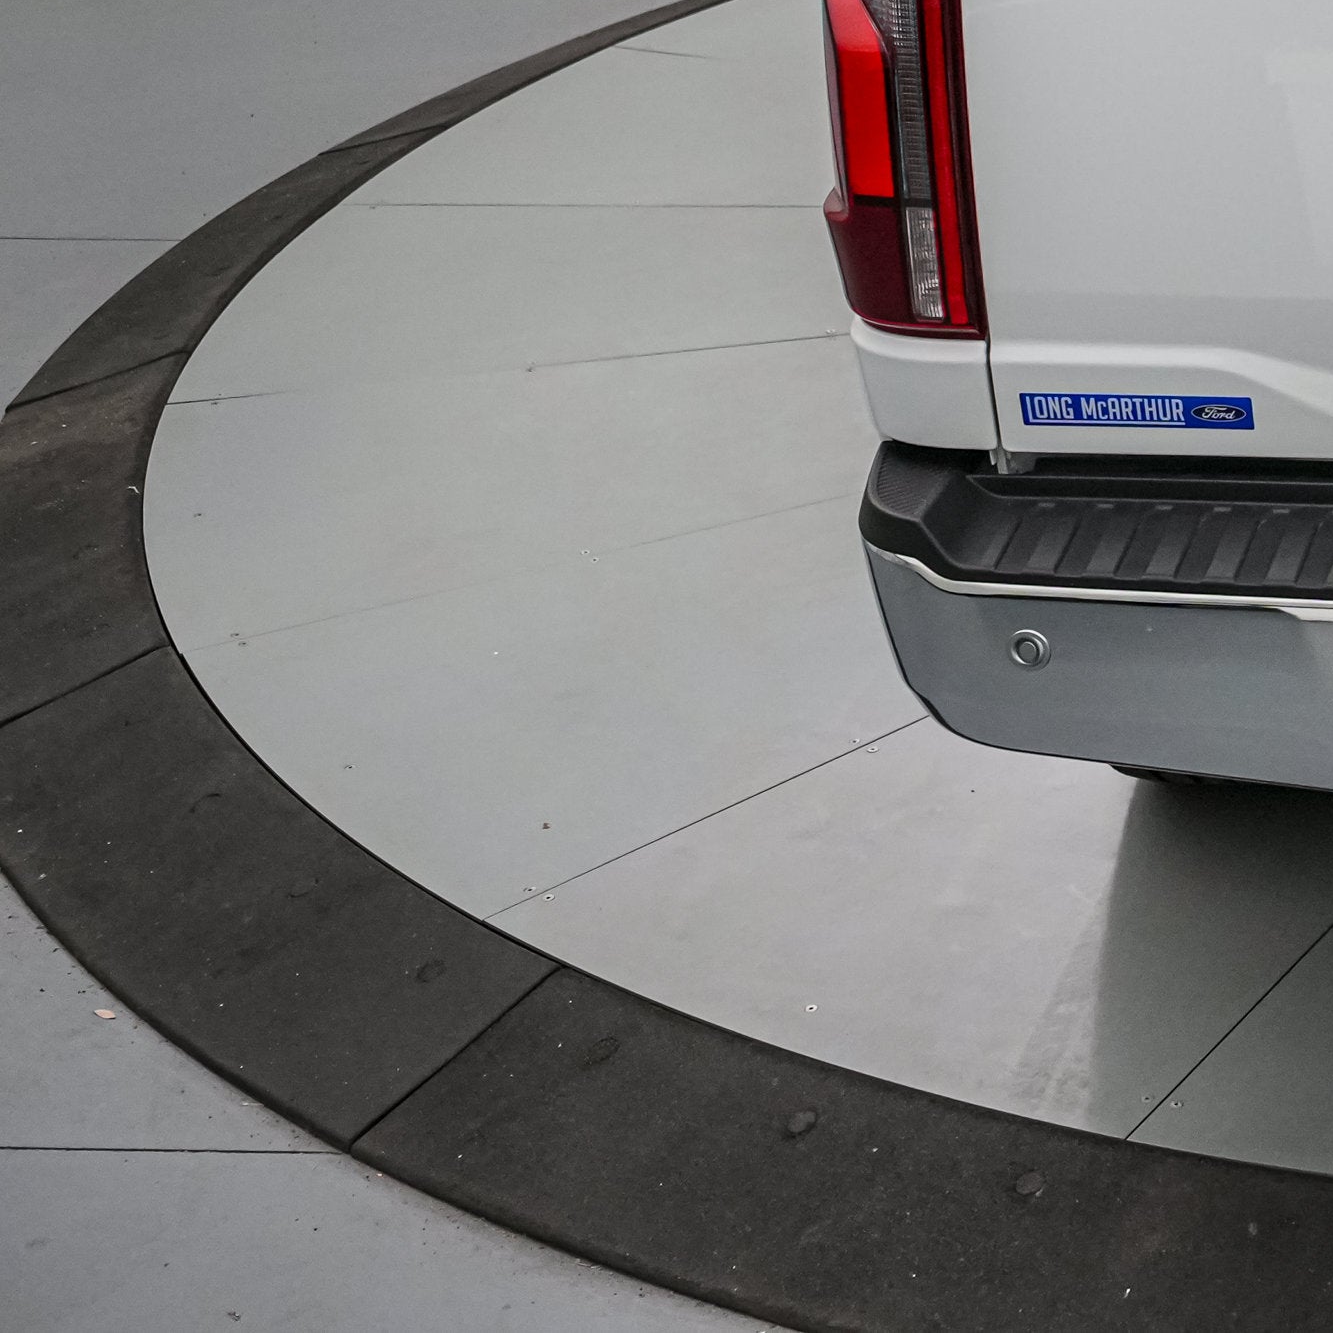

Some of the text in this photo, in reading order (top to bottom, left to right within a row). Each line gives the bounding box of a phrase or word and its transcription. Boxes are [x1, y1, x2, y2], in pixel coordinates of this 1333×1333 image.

[1025, 396, 1236, 423] LONG McARTHUR Ford
